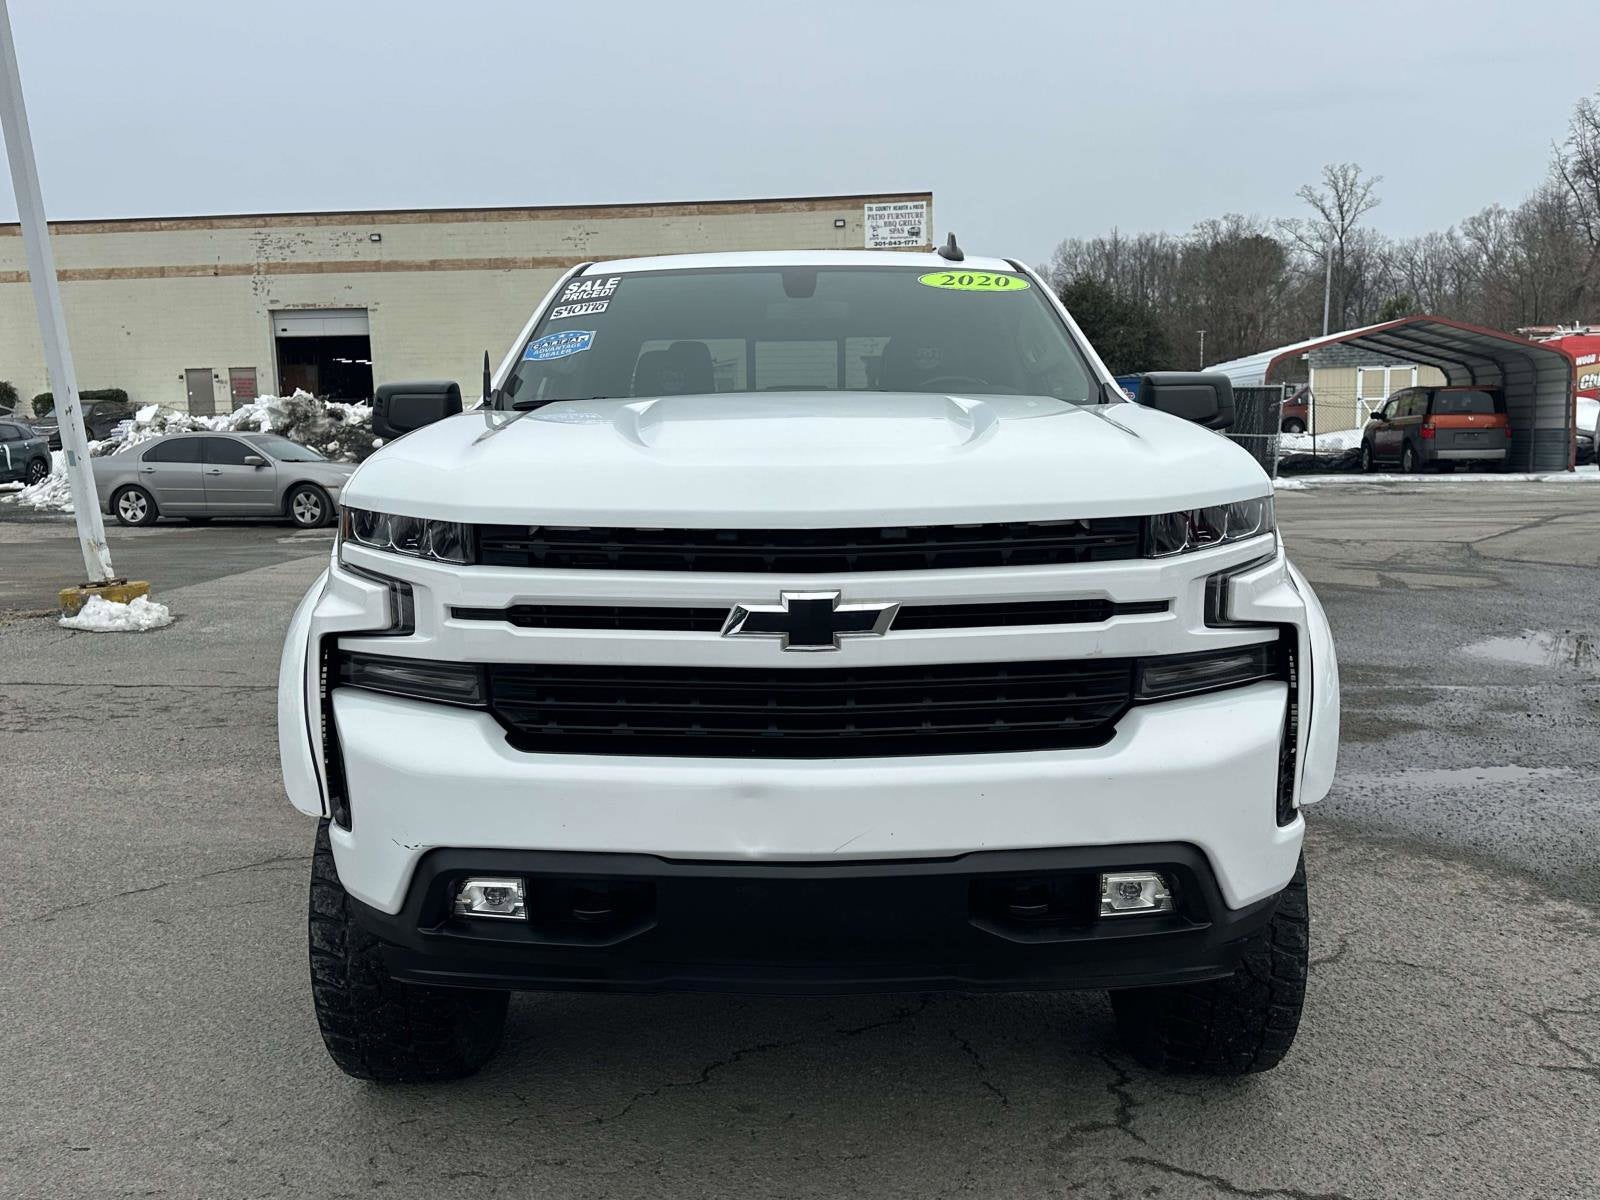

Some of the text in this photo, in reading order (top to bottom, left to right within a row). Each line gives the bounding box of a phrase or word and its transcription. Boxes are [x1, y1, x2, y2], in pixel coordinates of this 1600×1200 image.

[887, 212, 924, 220] FURNITURE
[565, 277, 621, 294] SALE
[940, 274, 1009, 287] 2020
[560, 288, 615, 303] PRICED!
[533, 343, 582, 355] ADVANTAGE
[539, 348, 572, 358] DEALER
